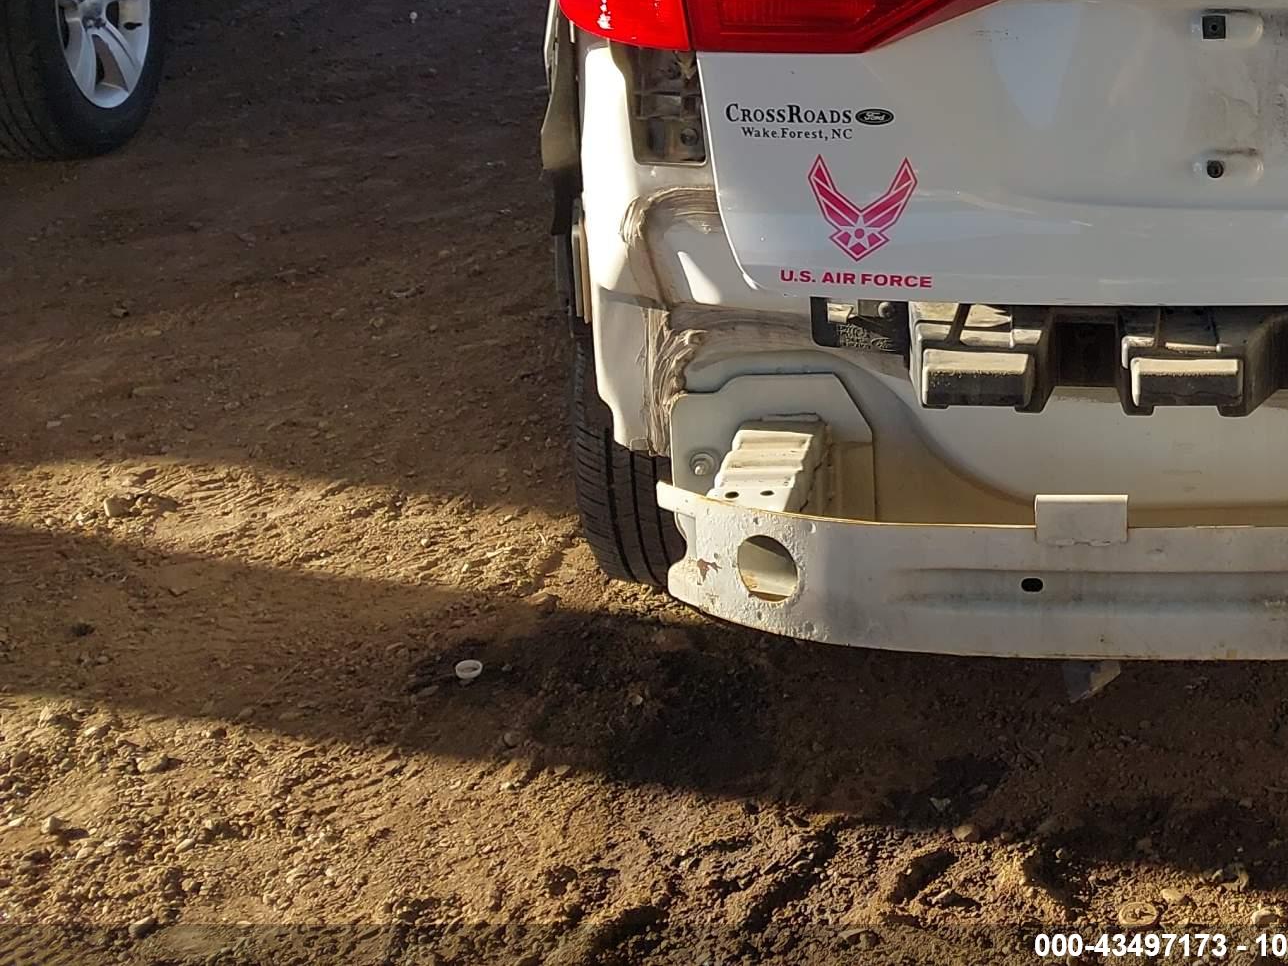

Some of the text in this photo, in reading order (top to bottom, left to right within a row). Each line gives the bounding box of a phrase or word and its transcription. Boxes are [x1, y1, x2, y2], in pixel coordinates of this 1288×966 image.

[741, 127, 853, 141] Wake Forest, NC
[780, 269, 933, 288] U.S. AIR FORCE
